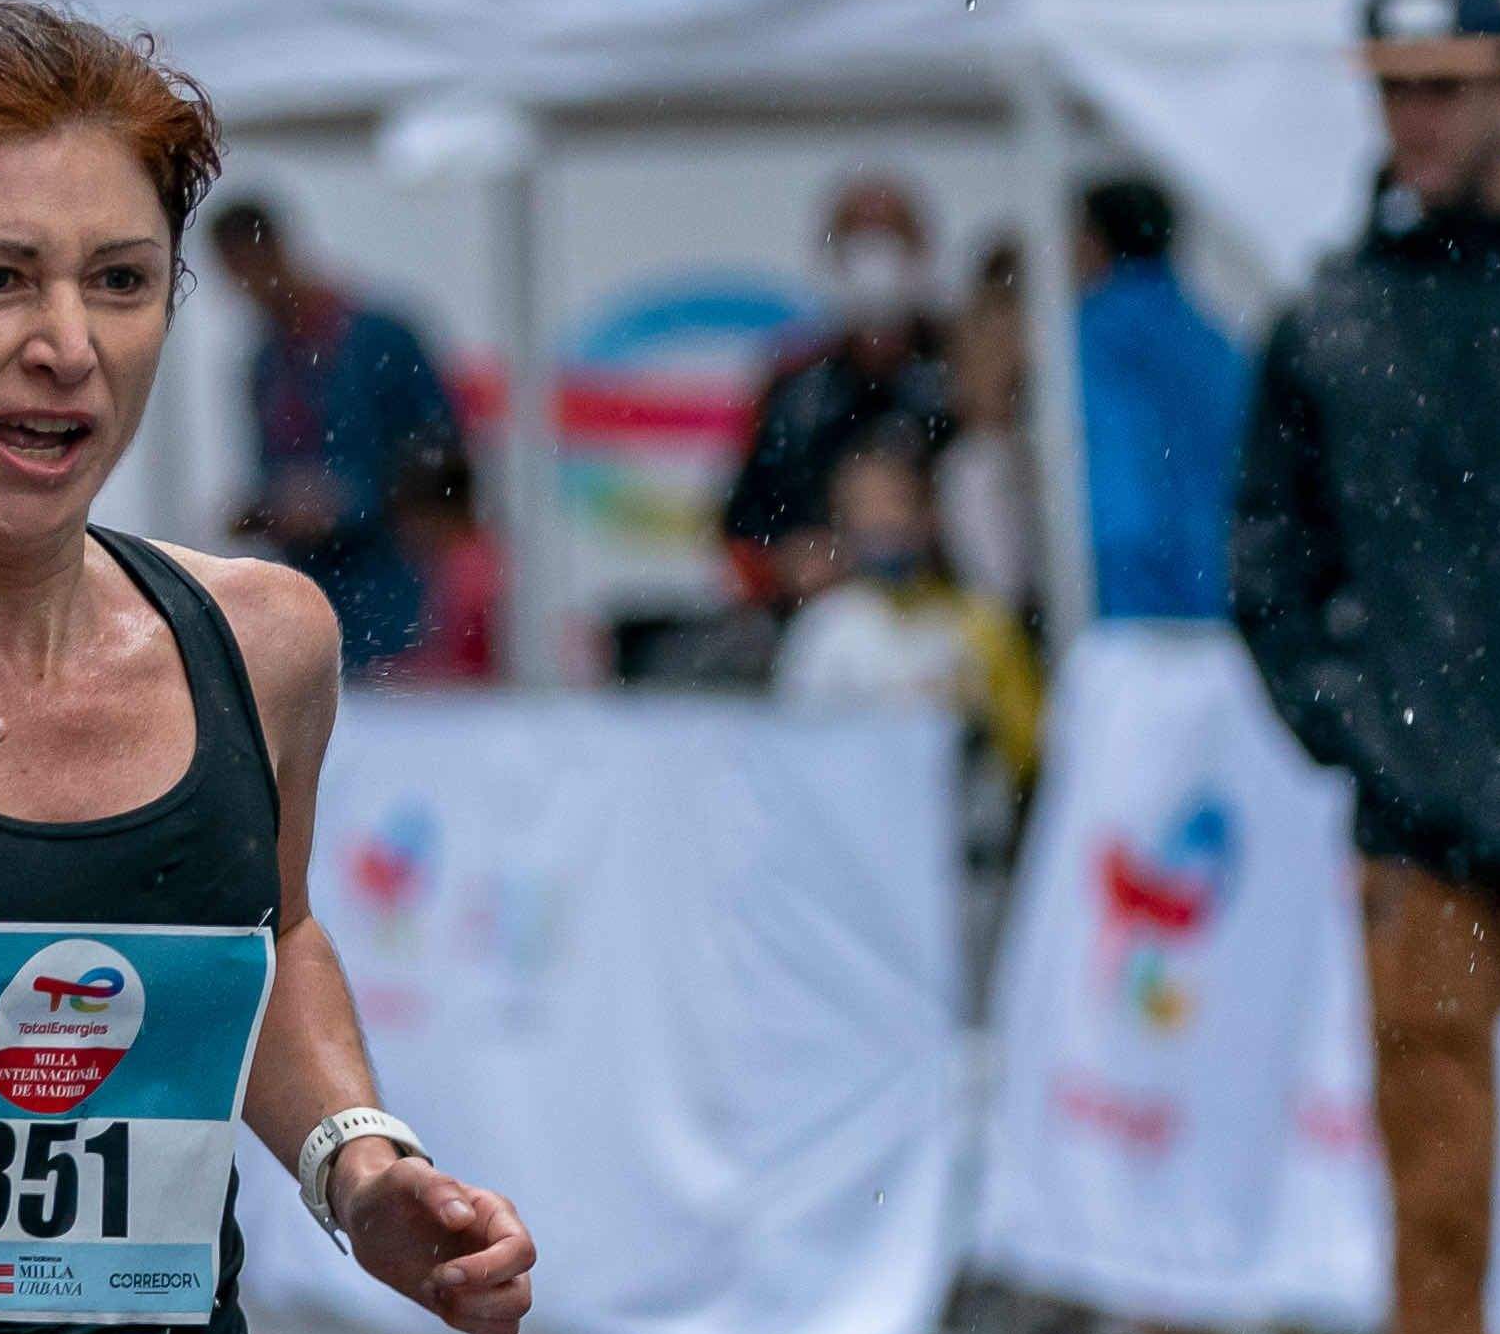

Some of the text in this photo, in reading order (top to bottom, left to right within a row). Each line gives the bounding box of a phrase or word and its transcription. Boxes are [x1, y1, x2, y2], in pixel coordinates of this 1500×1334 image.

[19, 1021, 108, 1037] TotalEnergies
[34, 1053, 77, 1066] MILLA
[11, 1084, 86, 1098] DE MADRID
[20, 1265, 74, 1279] MILLA
[19, 1281, 83, 1296] URBANA
